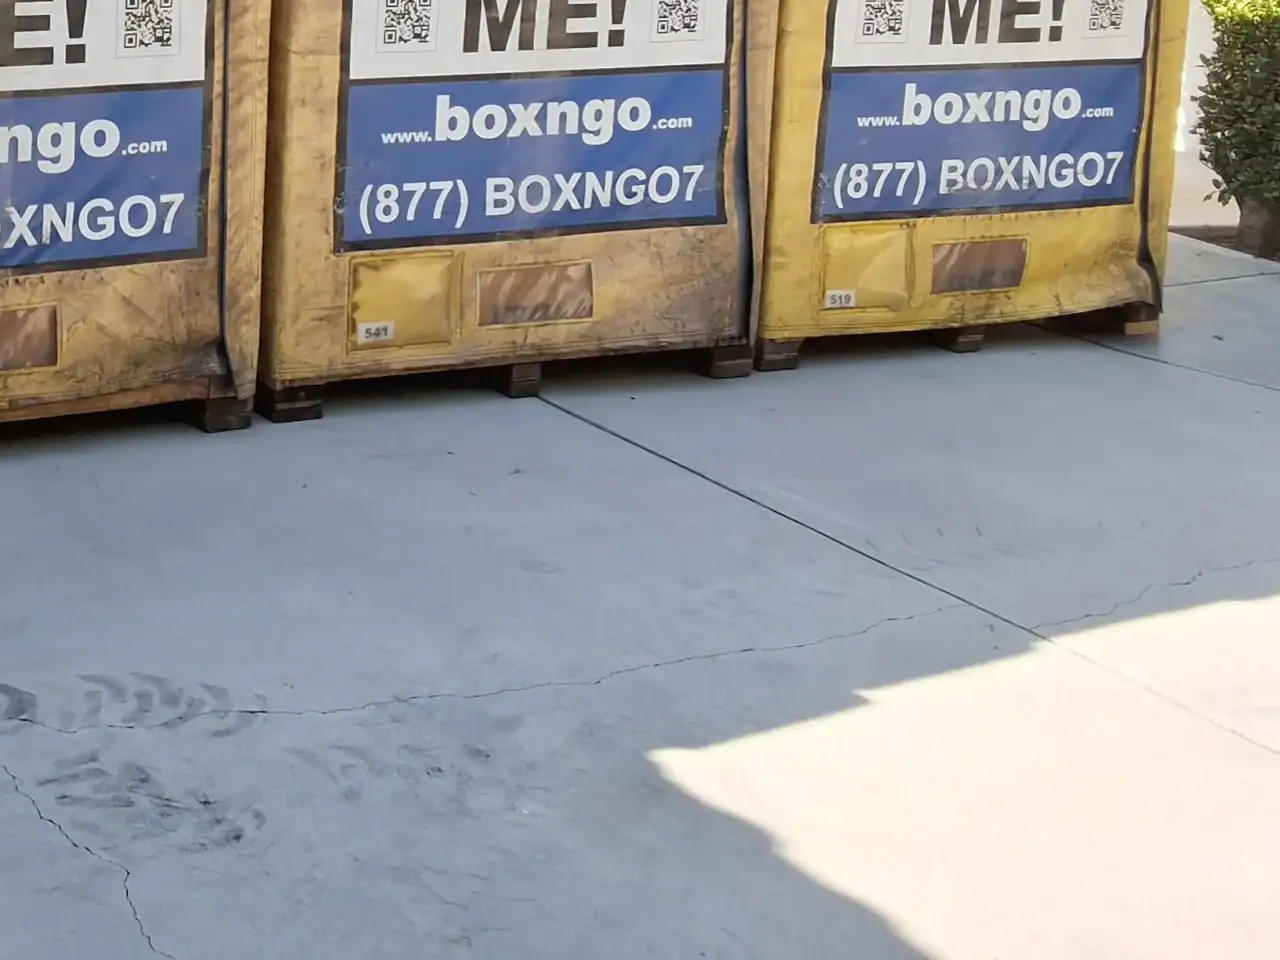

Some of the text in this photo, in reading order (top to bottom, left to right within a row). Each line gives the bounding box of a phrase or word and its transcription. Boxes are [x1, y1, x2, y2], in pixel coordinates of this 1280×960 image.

[359, 164, 705, 234] (877) BOXNGO7
[833, 151, 1124, 209] (877) BOXNGO7
